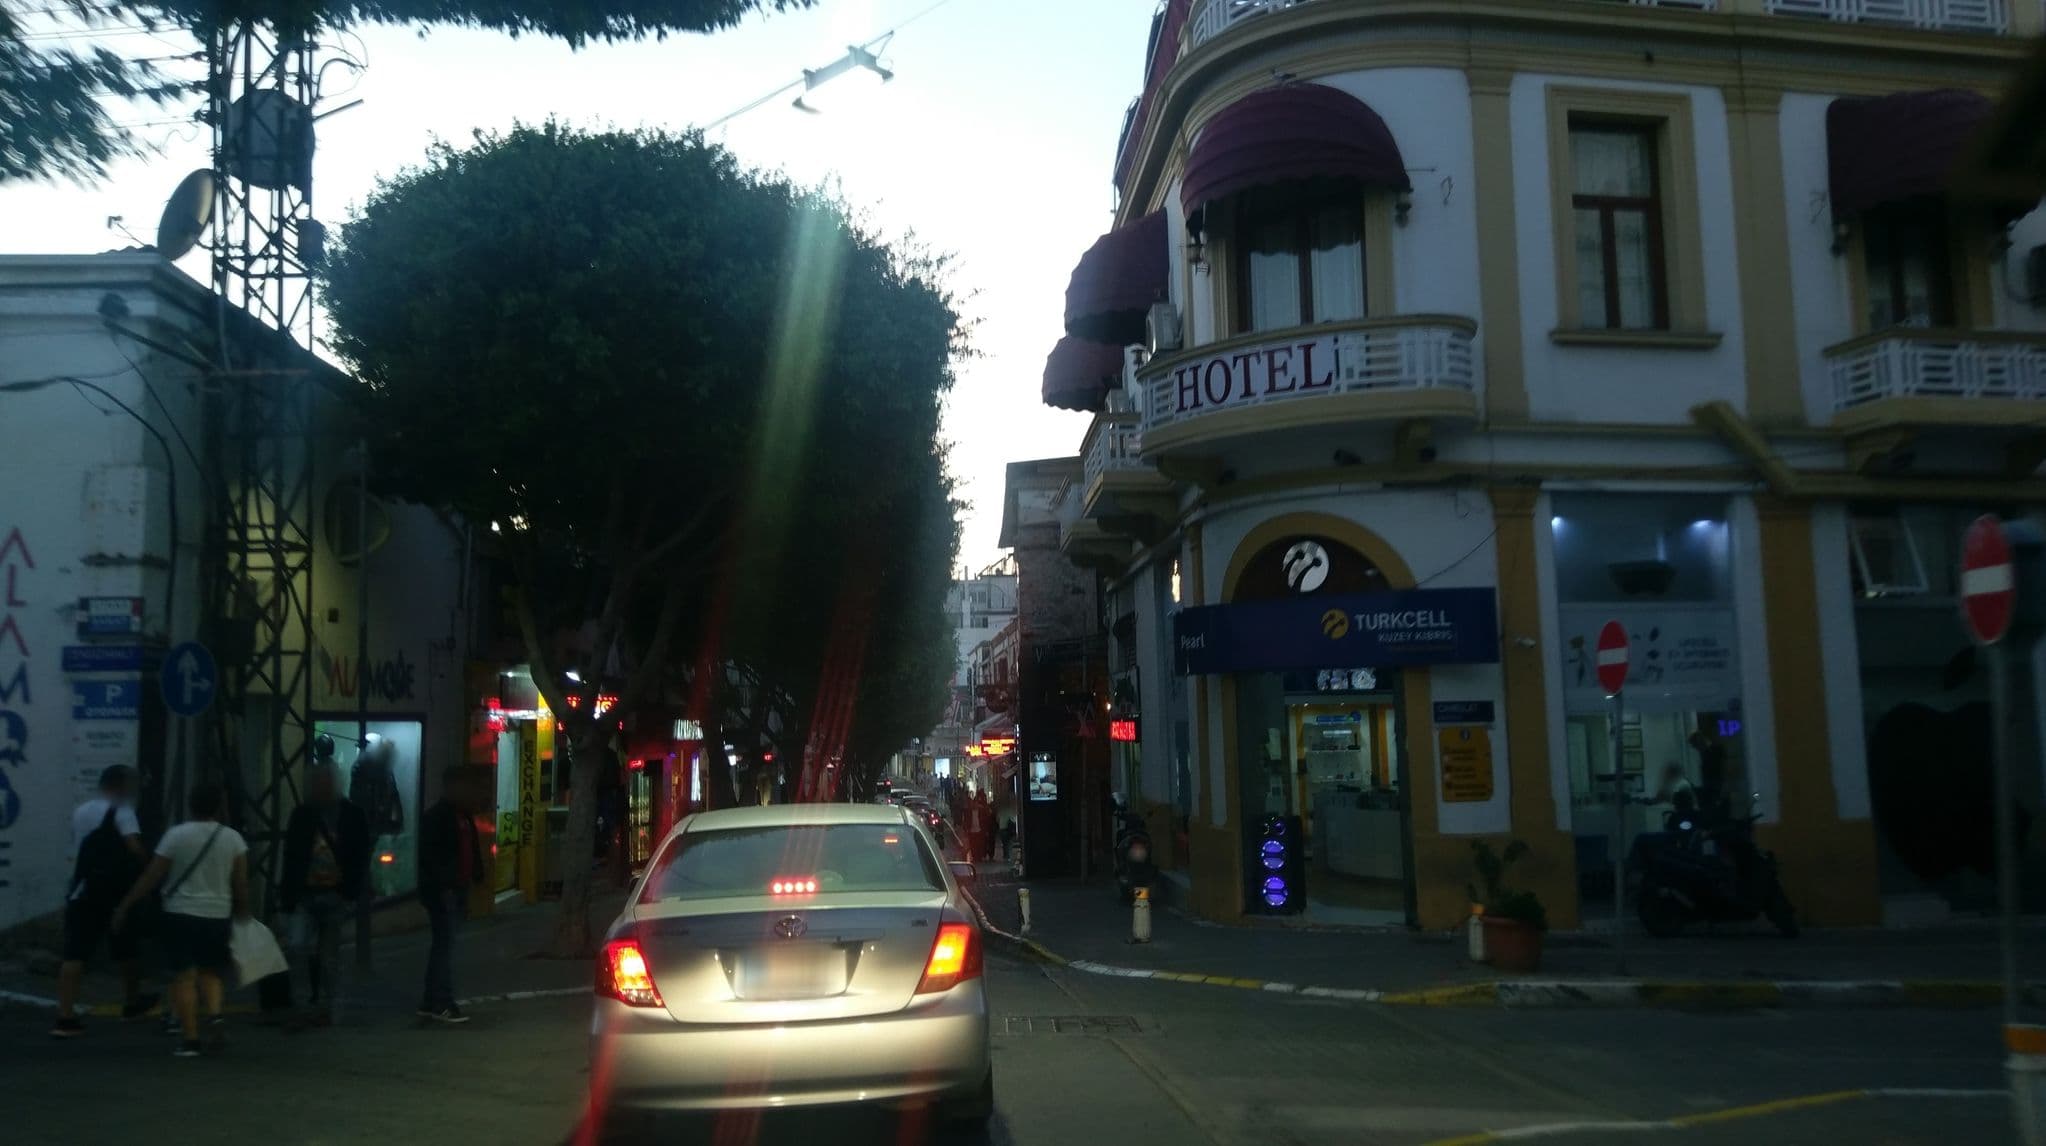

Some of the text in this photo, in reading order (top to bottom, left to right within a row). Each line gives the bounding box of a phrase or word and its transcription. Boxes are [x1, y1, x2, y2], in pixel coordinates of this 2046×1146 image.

[1175, 344, 1333, 412] HOTEL
[1354, 610, 1452, 631] TURKCELL
[1180, 631, 1205, 649] Pearl
[1378, 632, 1412, 643] KUZEY
[521, 740, 534, 846] EXCHANGE
